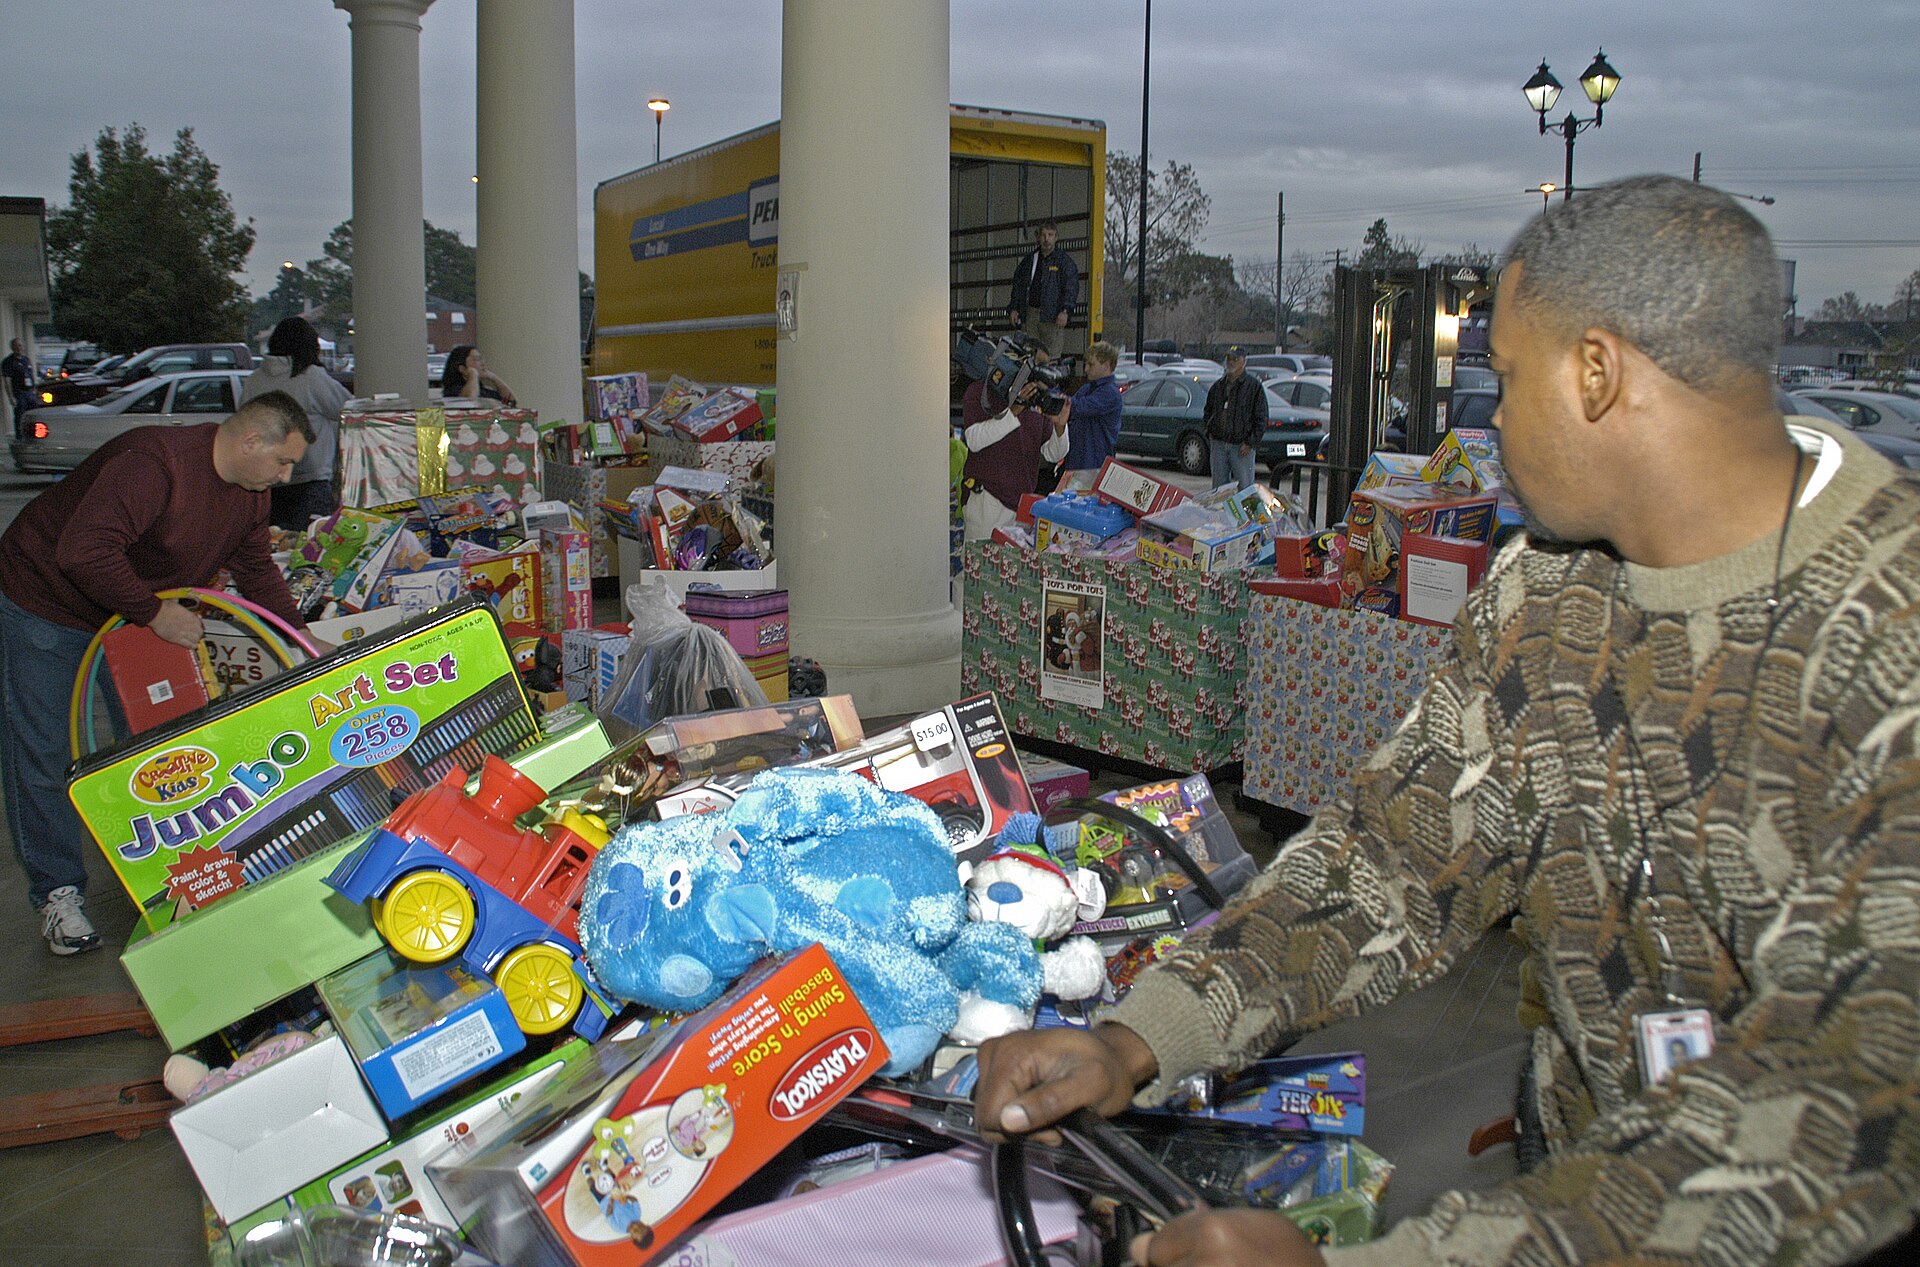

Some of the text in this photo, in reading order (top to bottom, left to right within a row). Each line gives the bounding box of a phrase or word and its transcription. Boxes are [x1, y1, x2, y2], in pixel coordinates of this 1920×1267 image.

[752, 198, 778, 225] PEN
[1046, 580, 1104, 595] TOYS FOR TOTS
[474, 616, 484, 625] UP
[205, 641, 261, 663] OYS
[217, 662, 263, 681] OTS
[308, 651, 459, 730] Art Set
[350, 708, 386, 730] Over
[916, 722, 949, 742] $15.00
[342, 715, 410, 760] 258
[365, 742, 405, 764] Pieces
[116, 730, 310, 862] Jumbo
[155, 776, 199, 801] Kids
[188, 869, 228, 892] color &
[195, 878, 234, 902] sketch!
[1127, 909, 1172, 931] EXTREME
[778, 966, 834, 1016] Baseball
[709, 993, 769, 1044] you swing away!
[793, 984, 846, 1027] Swing
[707, 1004, 776, 1058] The ball stays when
[707, 1012, 780, 1073] Arm-swinging action!
[732, 1034, 783, 1076] Score
[776, 1034, 867, 1115] PLAYSKOOL
[1279, 1089, 1313, 1116] TEK
